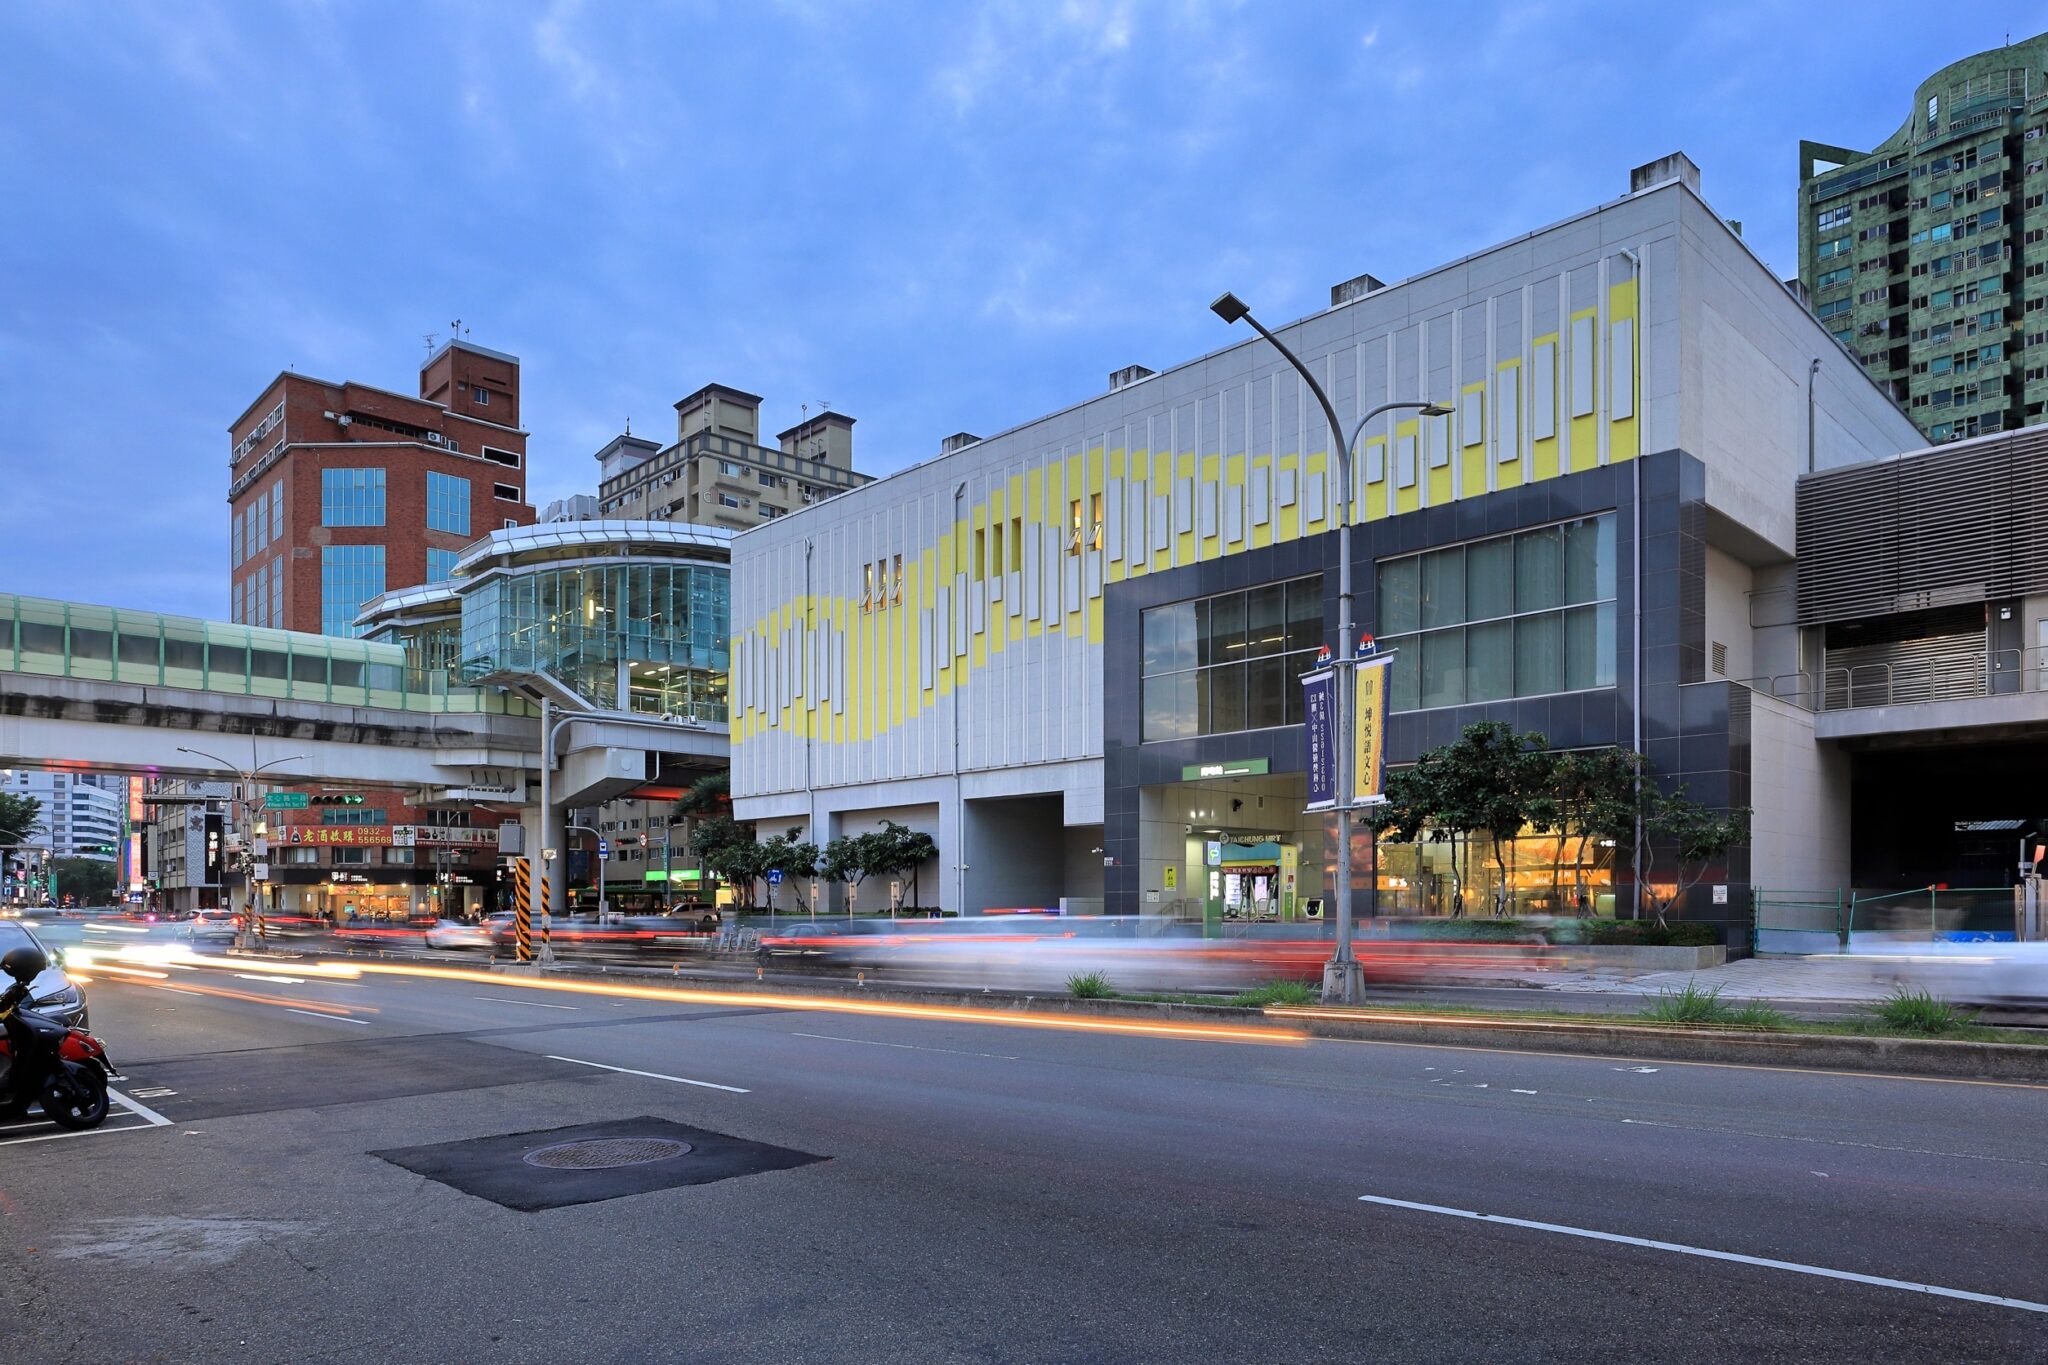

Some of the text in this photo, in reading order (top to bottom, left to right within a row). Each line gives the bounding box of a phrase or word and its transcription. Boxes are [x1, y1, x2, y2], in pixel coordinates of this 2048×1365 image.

[303, 828, 355, 844] 老酒收購
[357, 827, 386, 836] 0932-
[358, 836, 392, 845] 556569
[1229, 835, 1265, 845] TAICHUNG
